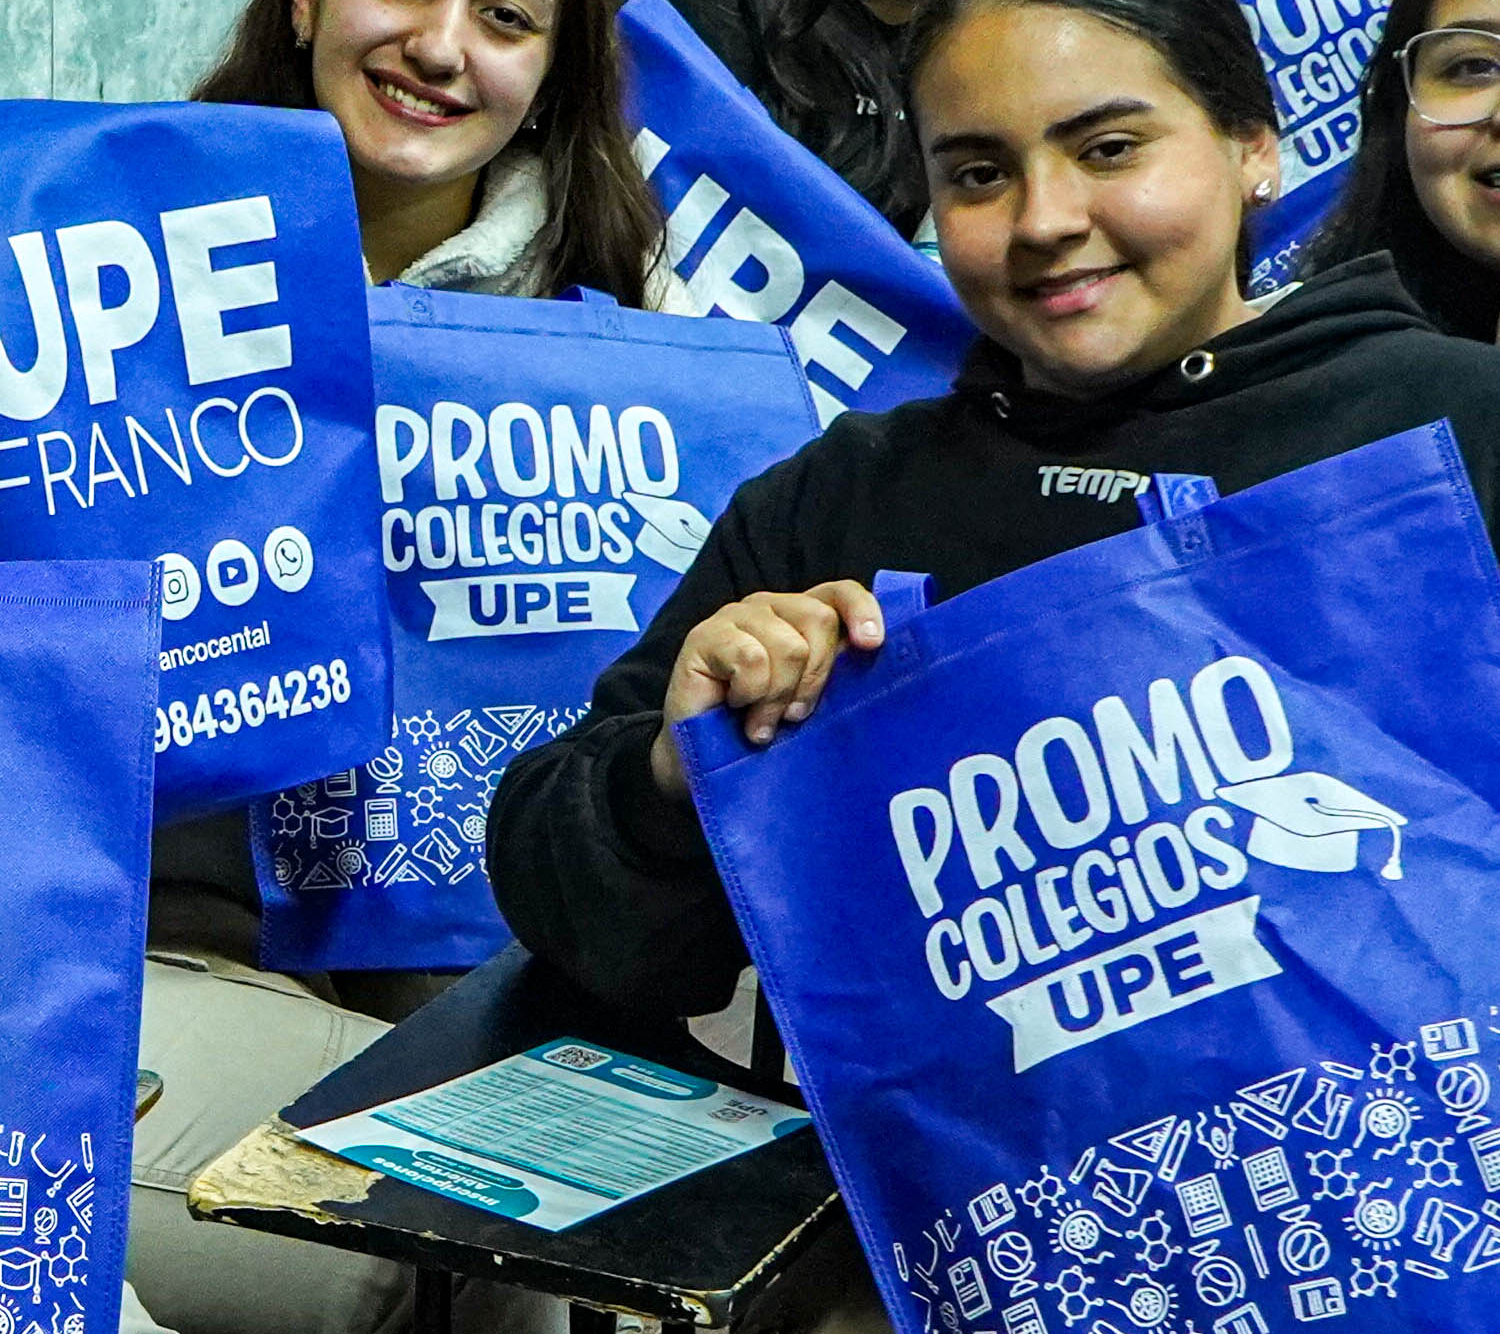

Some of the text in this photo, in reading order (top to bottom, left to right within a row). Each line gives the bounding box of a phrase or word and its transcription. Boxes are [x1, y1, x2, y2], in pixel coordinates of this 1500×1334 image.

[1294, 111, 1360, 168] UP
[376, 403, 680, 502] PROMO
[469, 583, 594, 625] UPE
[154, 658, 351, 753] 984364238
[889, 656, 1294, 918] PROMO
[1047, 939, 1217, 1034] UPE
[372, 1157, 501, 1206] Inscripciones
[411, 1160, 491, 1190] Abiertas
